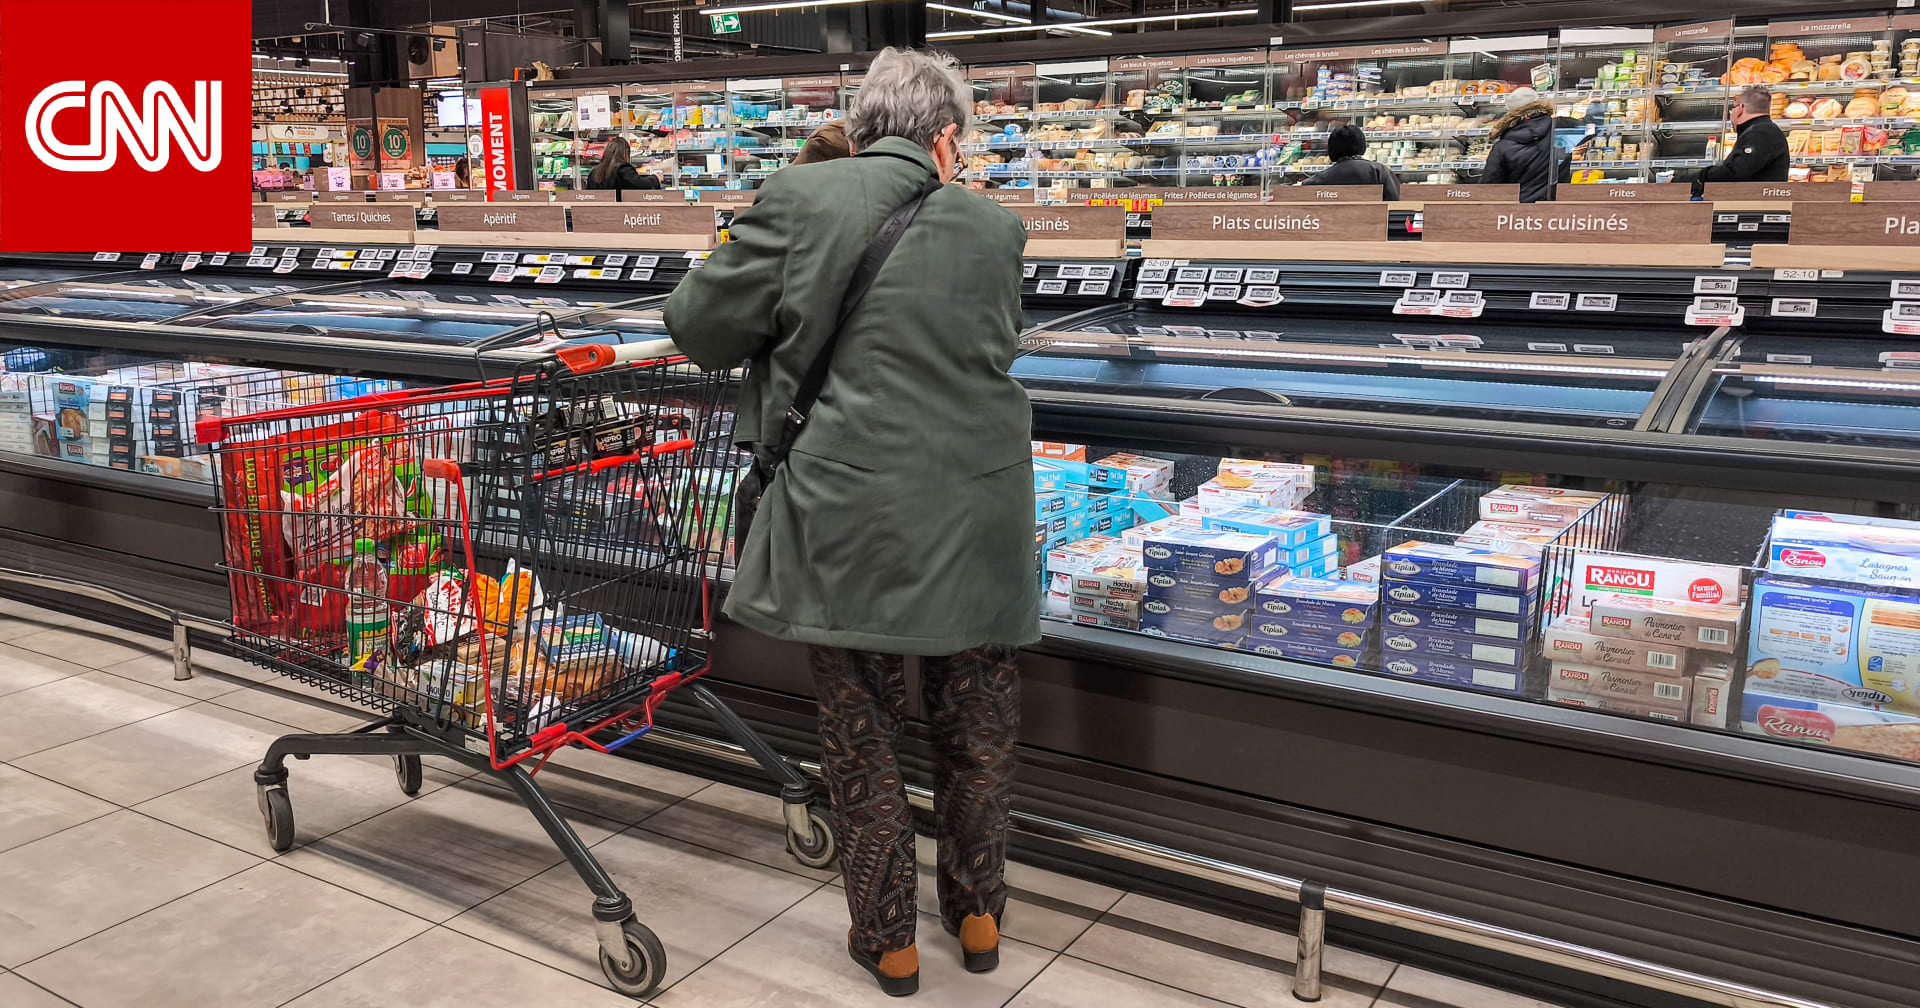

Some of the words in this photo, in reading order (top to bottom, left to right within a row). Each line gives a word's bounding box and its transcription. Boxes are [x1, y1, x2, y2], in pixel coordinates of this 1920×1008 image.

[1800, 24, 1810, 32] La
[1811, 22, 1851, 31] mozzarella
[994, 192, 1020, 201] légumes
[1227, 192, 1257, 201] légumes
[1447, 189, 1470, 198] Frites
[1609, 188, 1636, 197] Frites
[1763, 188, 1791, 197] Frites
[332, 212, 355, 222] Tartes
[361, 212, 391, 223] Quiches
[484, 213, 517, 226] Apéritif
[624, 213, 661, 227] Apéritif
[1212, 216, 1252, 230] Plats
[1254, 215, 1320, 230] cuisinés
[1496, 214, 1543, 231] Plats
[1548, 214, 1628, 231] cuisinés
[1022, 216, 1070, 231] uisinés
[1885, 216, 1920, 234] Pla
[1784, 554, 1824, 567] Ranou
[1394, 564, 1417, 573] Tipiak
[1590, 568, 1650, 587] RANOU
[1394, 590, 1416, 599] Tipiak
[1266, 604, 1288, 613] Tipiak
[1393, 615, 1416, 624] Tipiak
[1604, 617, 1630, 627] RANOU
[1263, 626, 1284, 635] Tipiak
[1390, 639, 1412, 649] Tipiak
[1555, 641, 1582, 650] RANOU
[1390, 664, 1413, 674] Tipiak
[1561, 670, 1588, 680] RANOU
[1709, 688, 1717, 714] RANOU
[1850, 689, 1887, 703] Tipiak
[1764, 716, 1828, 737] Ranou
